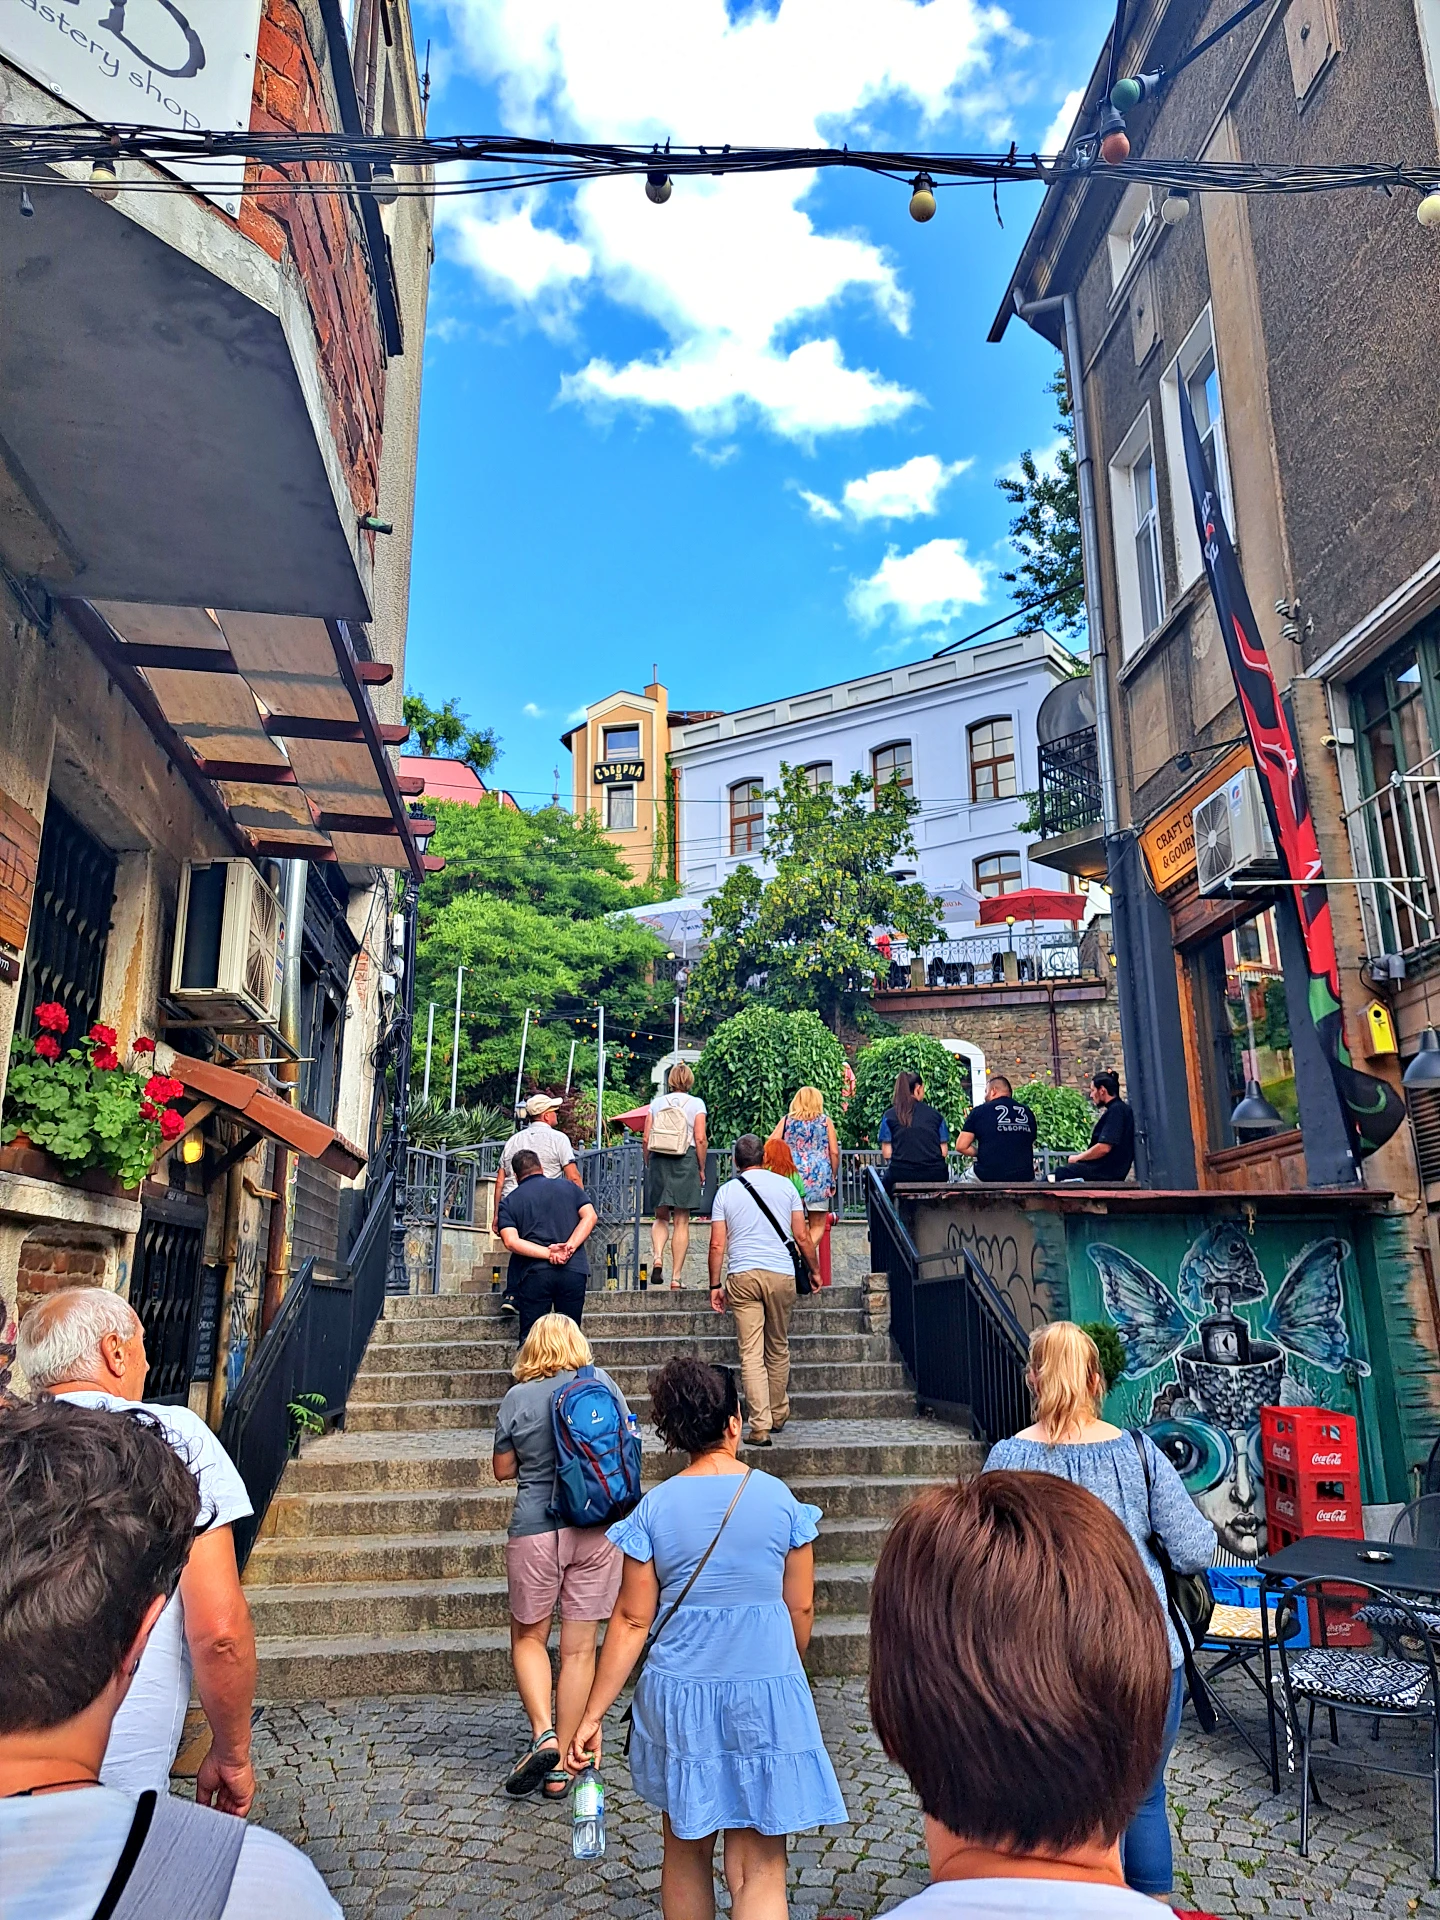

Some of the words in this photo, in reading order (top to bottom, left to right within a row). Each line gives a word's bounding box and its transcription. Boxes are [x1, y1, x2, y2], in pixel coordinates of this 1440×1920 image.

[20, 0, 120, 78] astery
[128, 70, 201, 130] shop
[1156, 820, 1183, 850] CRAFT
[1182, 810, 1194, 828] CH
[994, 1105, 1029, 1124] 23
[996, 1125, 1031, 1133] СЪБОРНА
